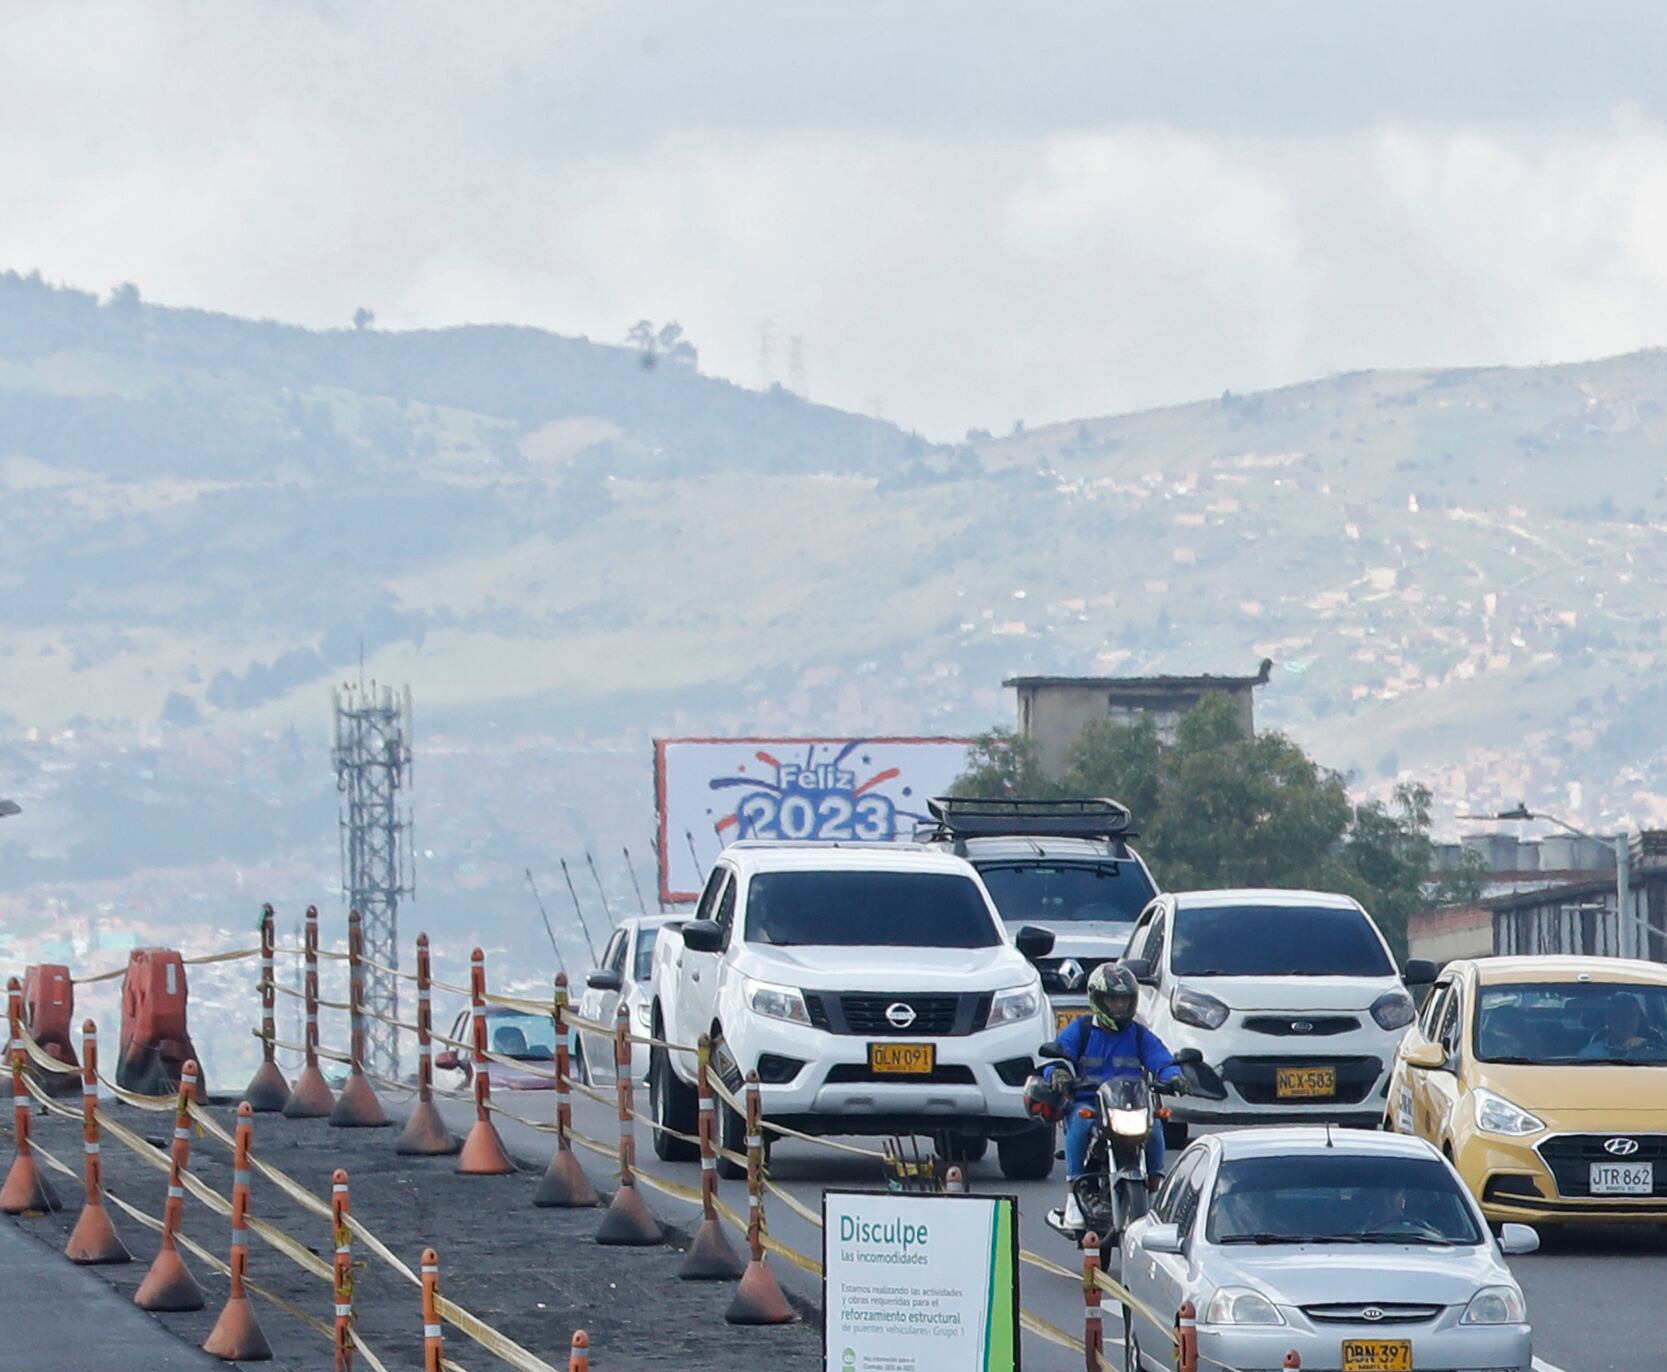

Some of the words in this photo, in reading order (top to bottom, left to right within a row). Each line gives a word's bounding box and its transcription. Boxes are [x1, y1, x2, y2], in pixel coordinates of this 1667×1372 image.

[779, 763, 854, 789] Feliz
[743, 796, 889, 840] 2023
[1593, 1169, 1619, 1185] JTR
[1623, 1169, 1650, 1185] 862
[840, 1215, 928, 1251] Disculpe
[841, 1250, 855, 1262] las
[857, 1250, 928, 1265] incomodidades
[841, 1308, 907, 1322] reforzamiento
[908, 1311, 961, 1324] estructural
